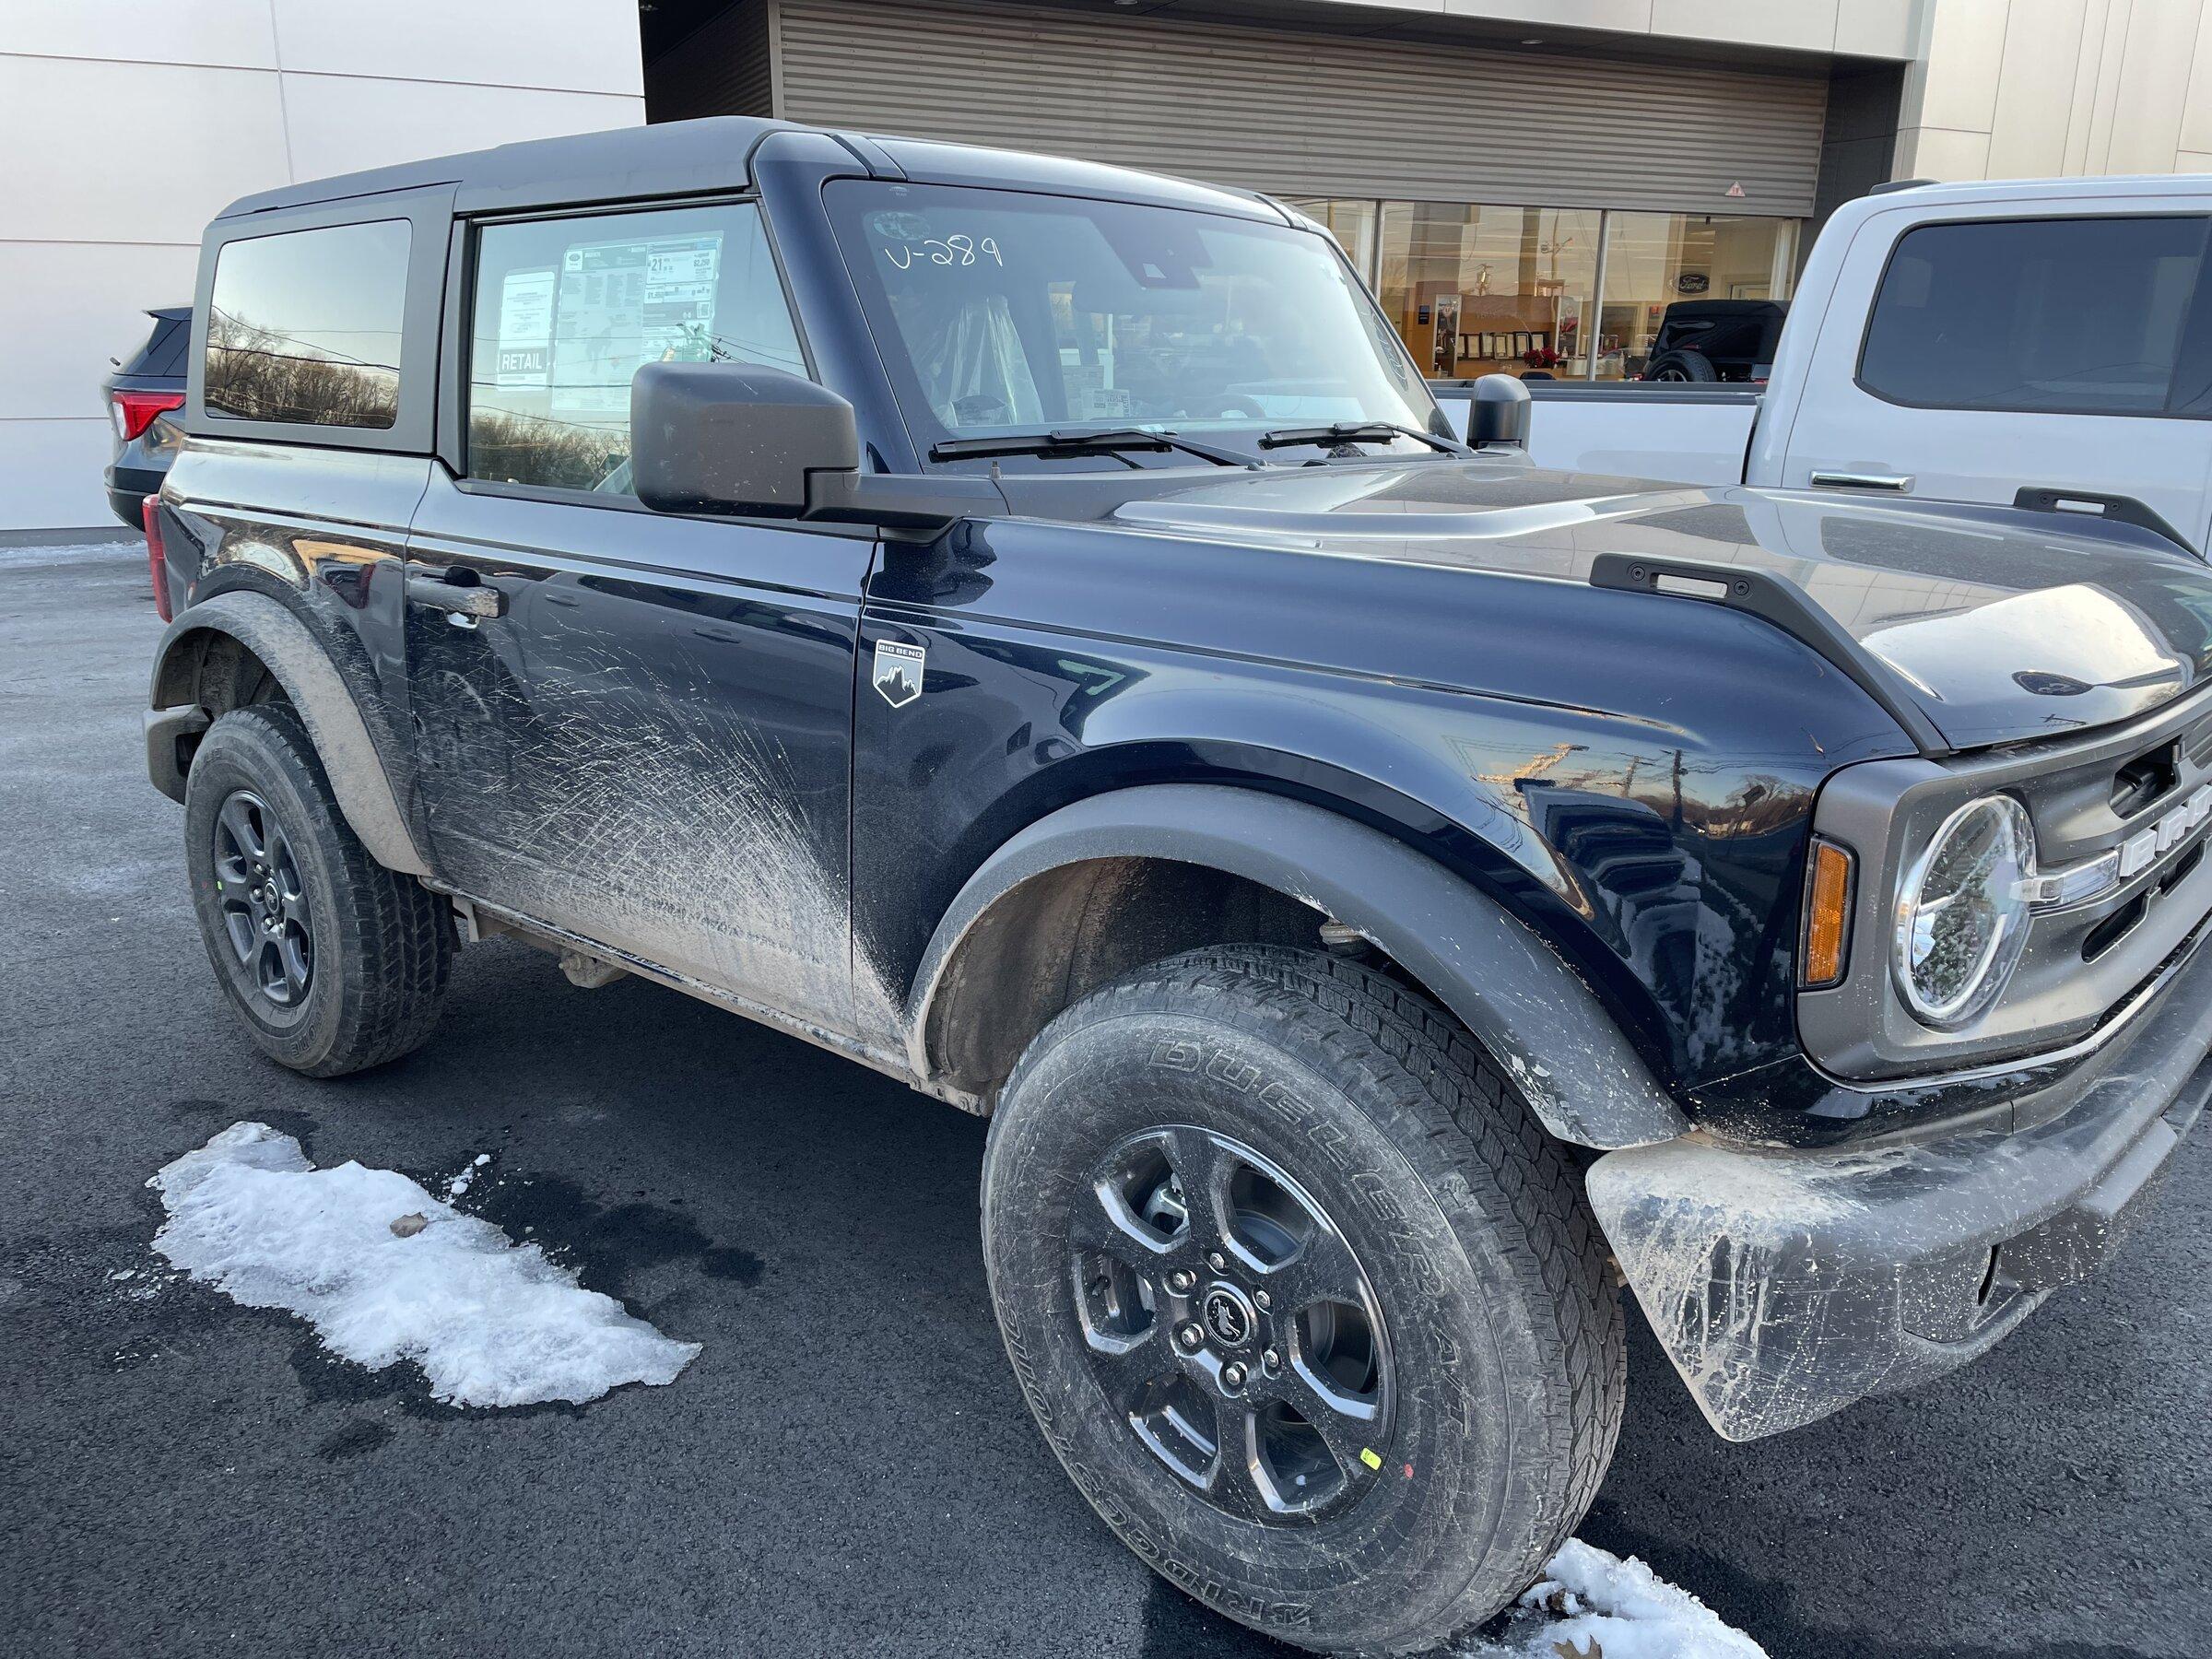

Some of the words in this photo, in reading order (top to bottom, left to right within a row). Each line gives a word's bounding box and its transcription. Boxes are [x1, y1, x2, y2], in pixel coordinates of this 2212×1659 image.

[1681, 276, 1705, 290] Ford
[501, 352, 543, 371] RETAIL
[878, 644, 895, 653] BIG
[897, 647, 923, 658] BEND
[1147, 1039, 1447, 1298] DUELER
[998, 1298, 1312, 1628] BRIDGESTONE
